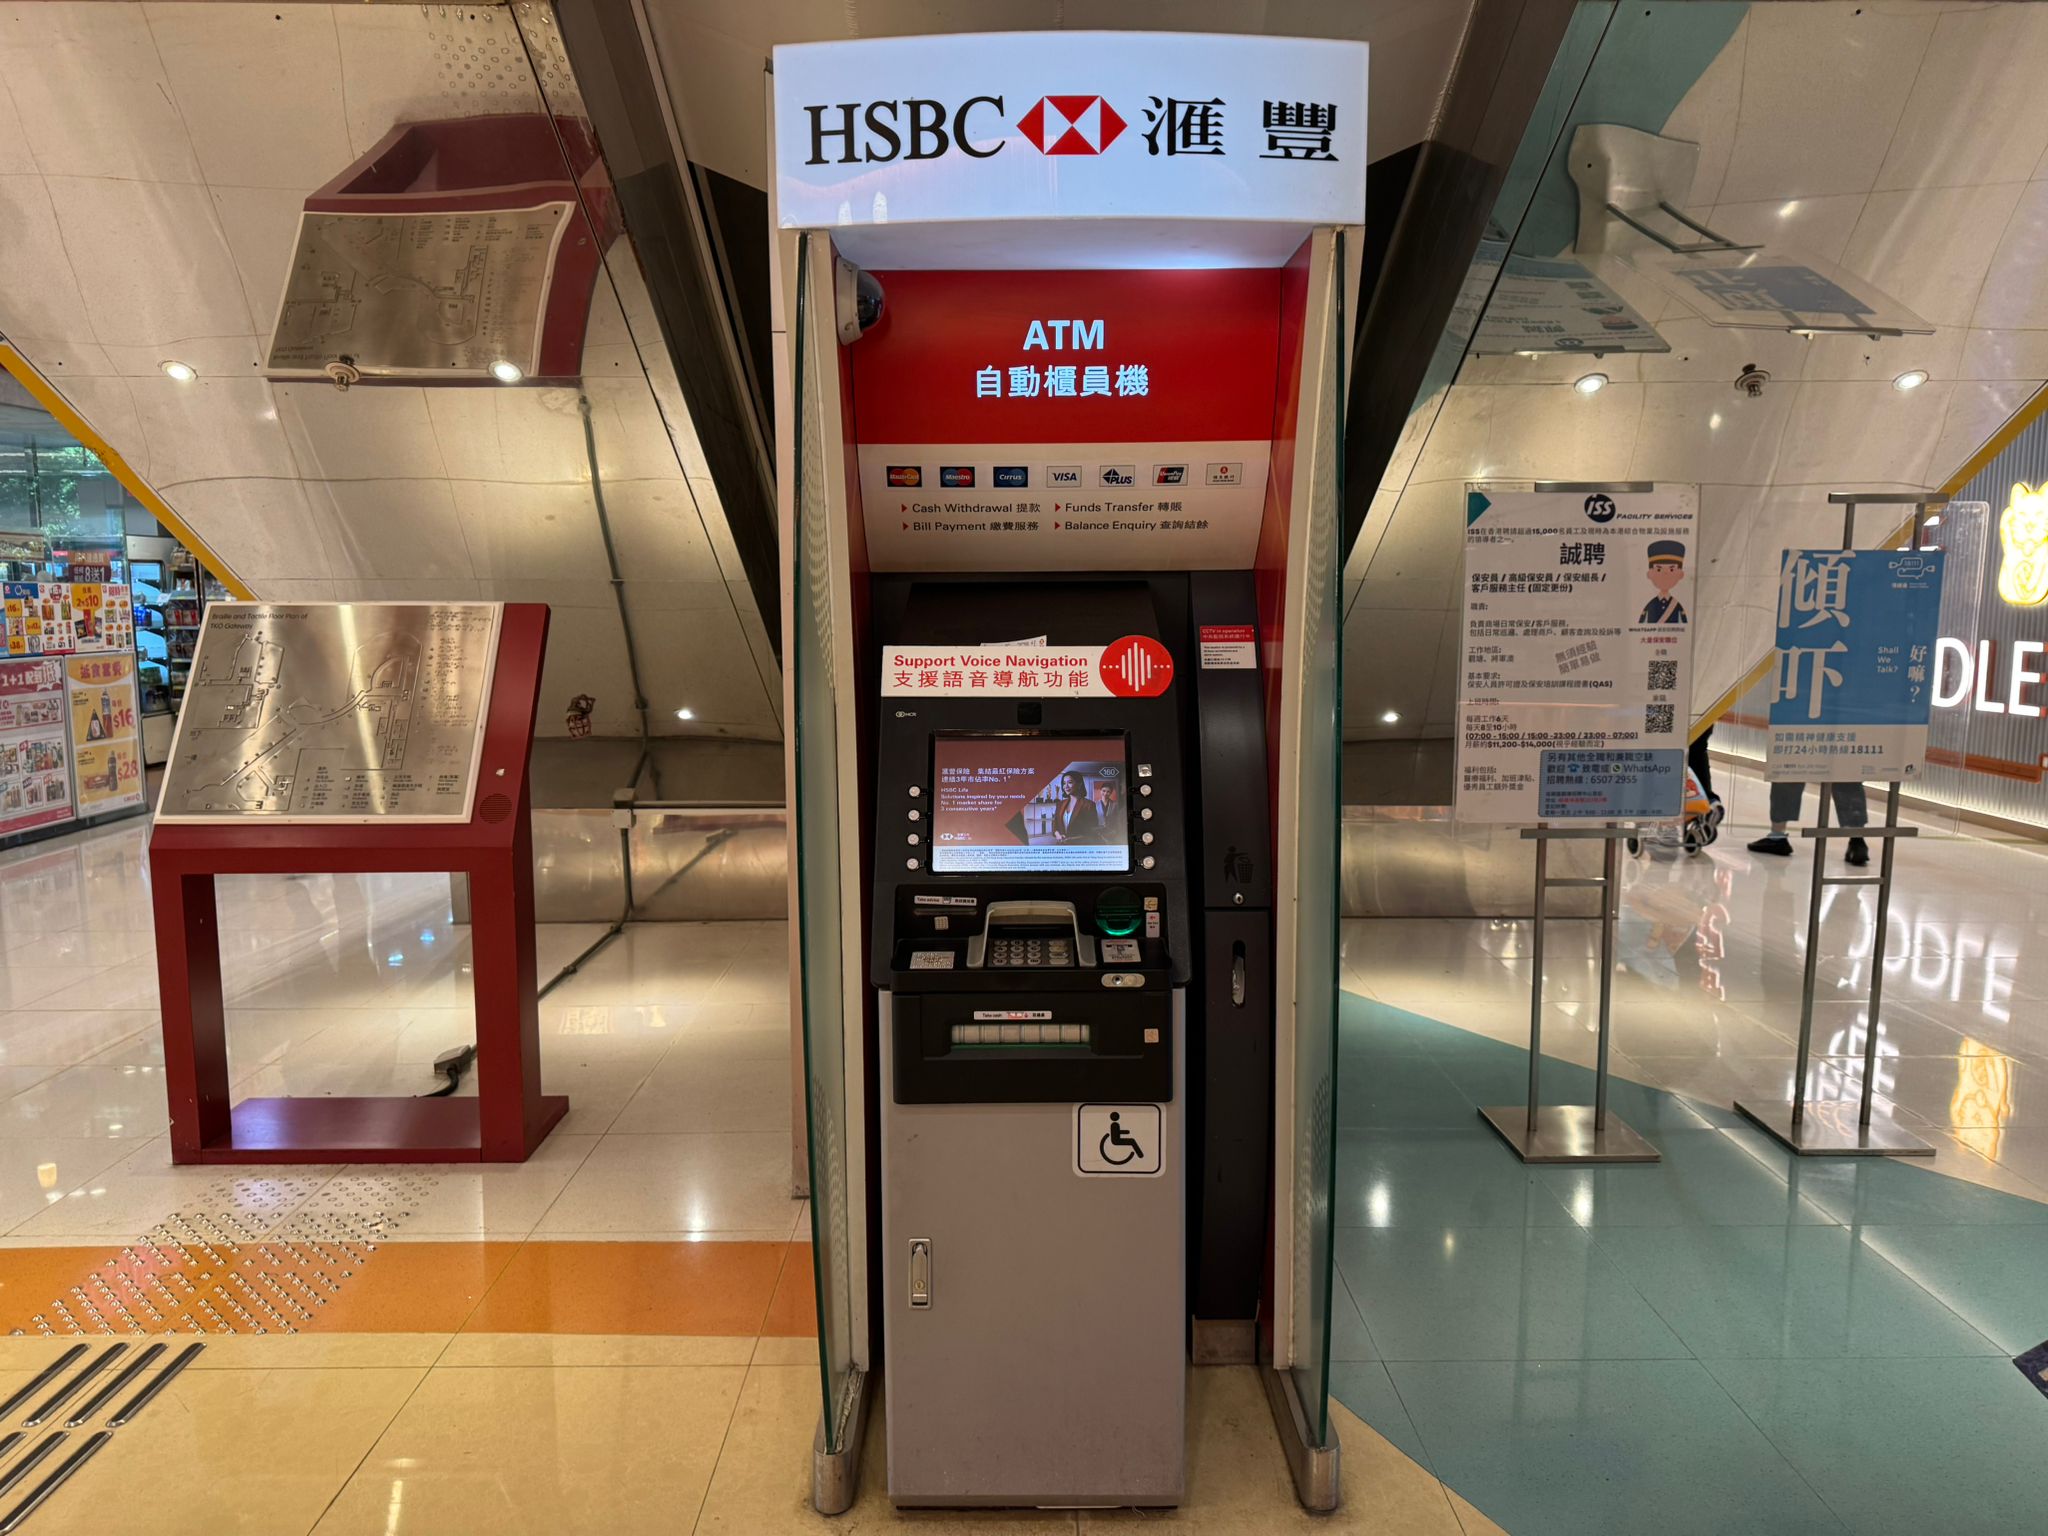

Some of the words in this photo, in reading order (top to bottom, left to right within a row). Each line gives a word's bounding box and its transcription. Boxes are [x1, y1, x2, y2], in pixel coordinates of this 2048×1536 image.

[803, 95, 1006, 165] HSBC
[1022, 319, 1105, 350] ATM
[975, 363, 1150, 398] 自動櫃員機
[1053, 472, 1077, 481] VISA
[1110, 475, 1133, 484] PLUS
[912, 503, 941, 513] Cash
[944, 503, 1013, 513] Withdrawal
[1016, 503, 1041, 513] 提款
[1065, 503, 1102, 513] Funds
[1105, 502, 1154, 512] Transfer
[913, 522, 931, 531] Bill
[935, 522, 986, 534] Payment
[990, 521, 1039, 532] 繳費服務
[1065, 521, 1109, 530] Balance
[1113, 521, 1157, 532] Enquiry
[1160, 520, 1208, 530] 查詢結餘
[1559, 542, 1606, 565] 誠聘
[1472, 573, 1499, 582] 保安員
[1508, 573, 1553, 582] 高級保安員
[1563, 573, 1599, 582] 保安組長
[1472, 583, 1526, 593] 客戶服務主任
[1878, 646, 1900, 654] Shall
[894, 655, 957, 669] Support
[961, 655, 1001, 667] Voice
[1005, 655, 1088, 669] Navigation
[1877, 656, 1892, 664] We
[1876, 665, 1899, 673] Talk?
[893, 670, 1089, 688] 支援語音導航功能
[113, 708, 135, 728] $16
[1499, 732, 1520, 740] 15:00
[1527, 732, 1549, 740] 15:00
[117, 759, 139, 782] $28
[1623, 763, 1671, 775] WhatsApp
[1590, 775, 1613, 784] 6507
[1614, 775, 1638, 784] 2955
